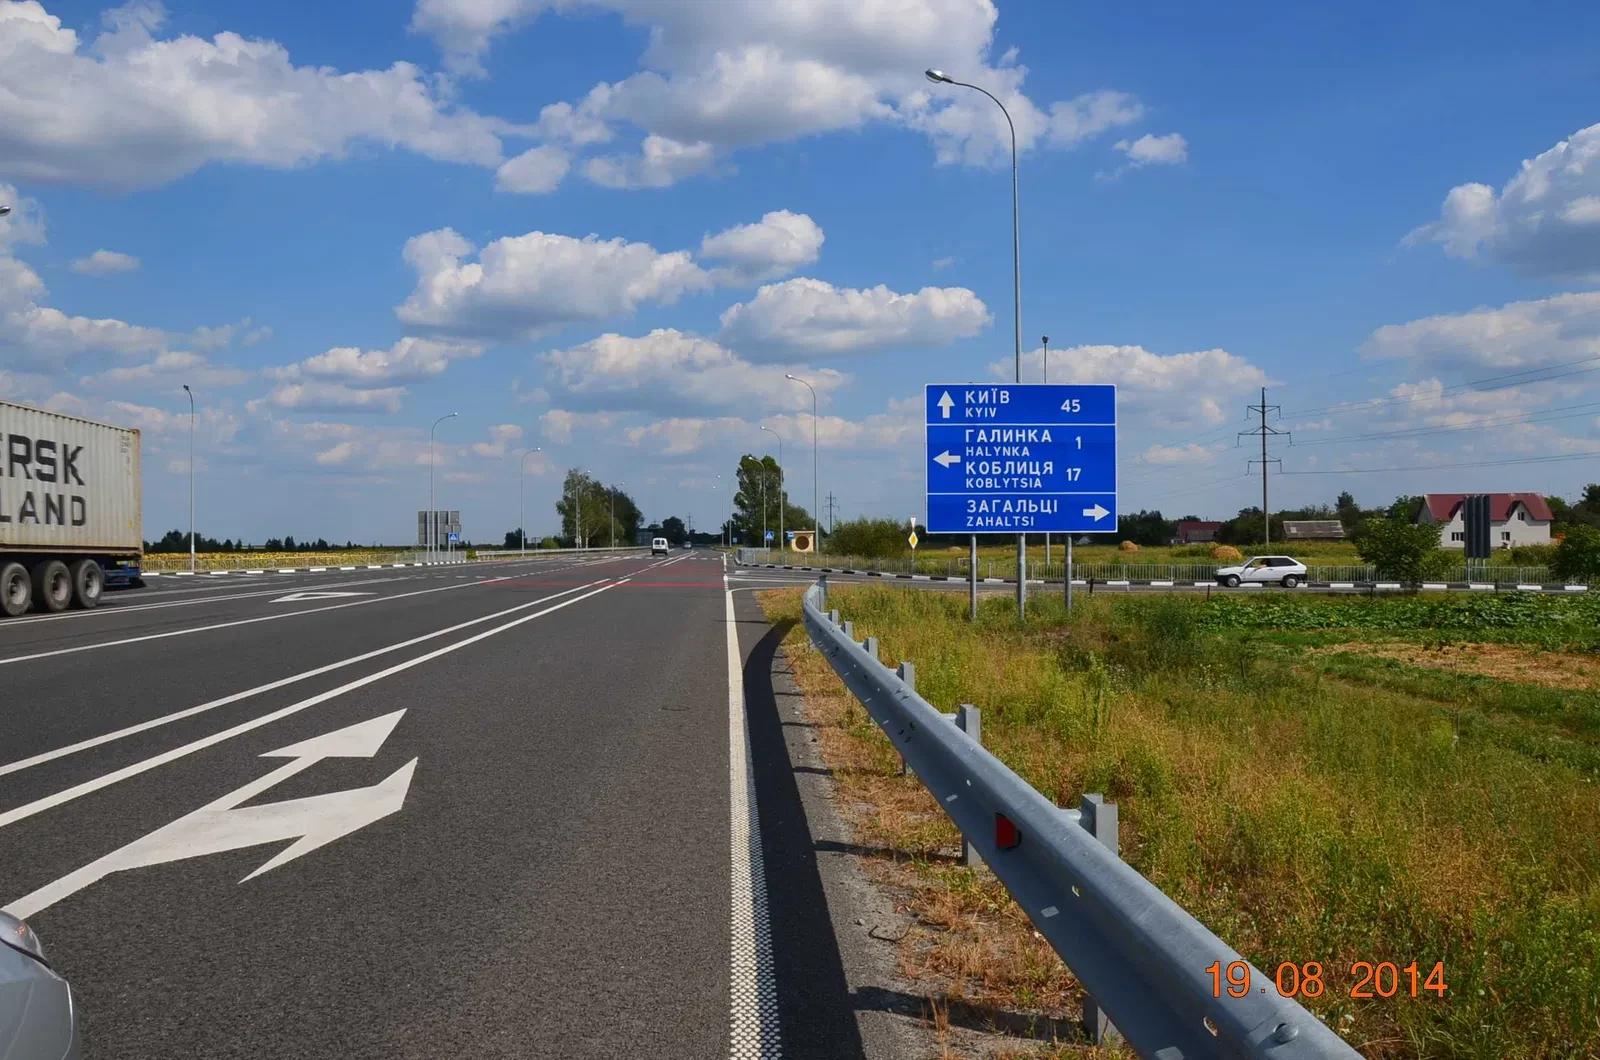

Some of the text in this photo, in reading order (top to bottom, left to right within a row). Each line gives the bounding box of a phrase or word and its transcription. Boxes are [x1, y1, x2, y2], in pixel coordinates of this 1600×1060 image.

[965, 388, 1010, 404] КИЇВ
[1061, 399, 1080, 412] 45
[965, 408, 997, 417] KYIV
[965, 429, 1052, 442] ГАЛИНКА
[1075, 436, 1081, 449] 1
[966, 447, 1030, 456] HALYNKA
[0, 432, 85, 486] RSK
[966, 461, 1053, 476] КОБЛИЦЯ
[1066, 468, 1081, 481] 17
[966, 478, 1042, 488] KOBLYTSIA
[967, 500, 1057, 514] ЗАГАЛЬЦІ
[967, 517, 1034, 526] ZAHALTSI
